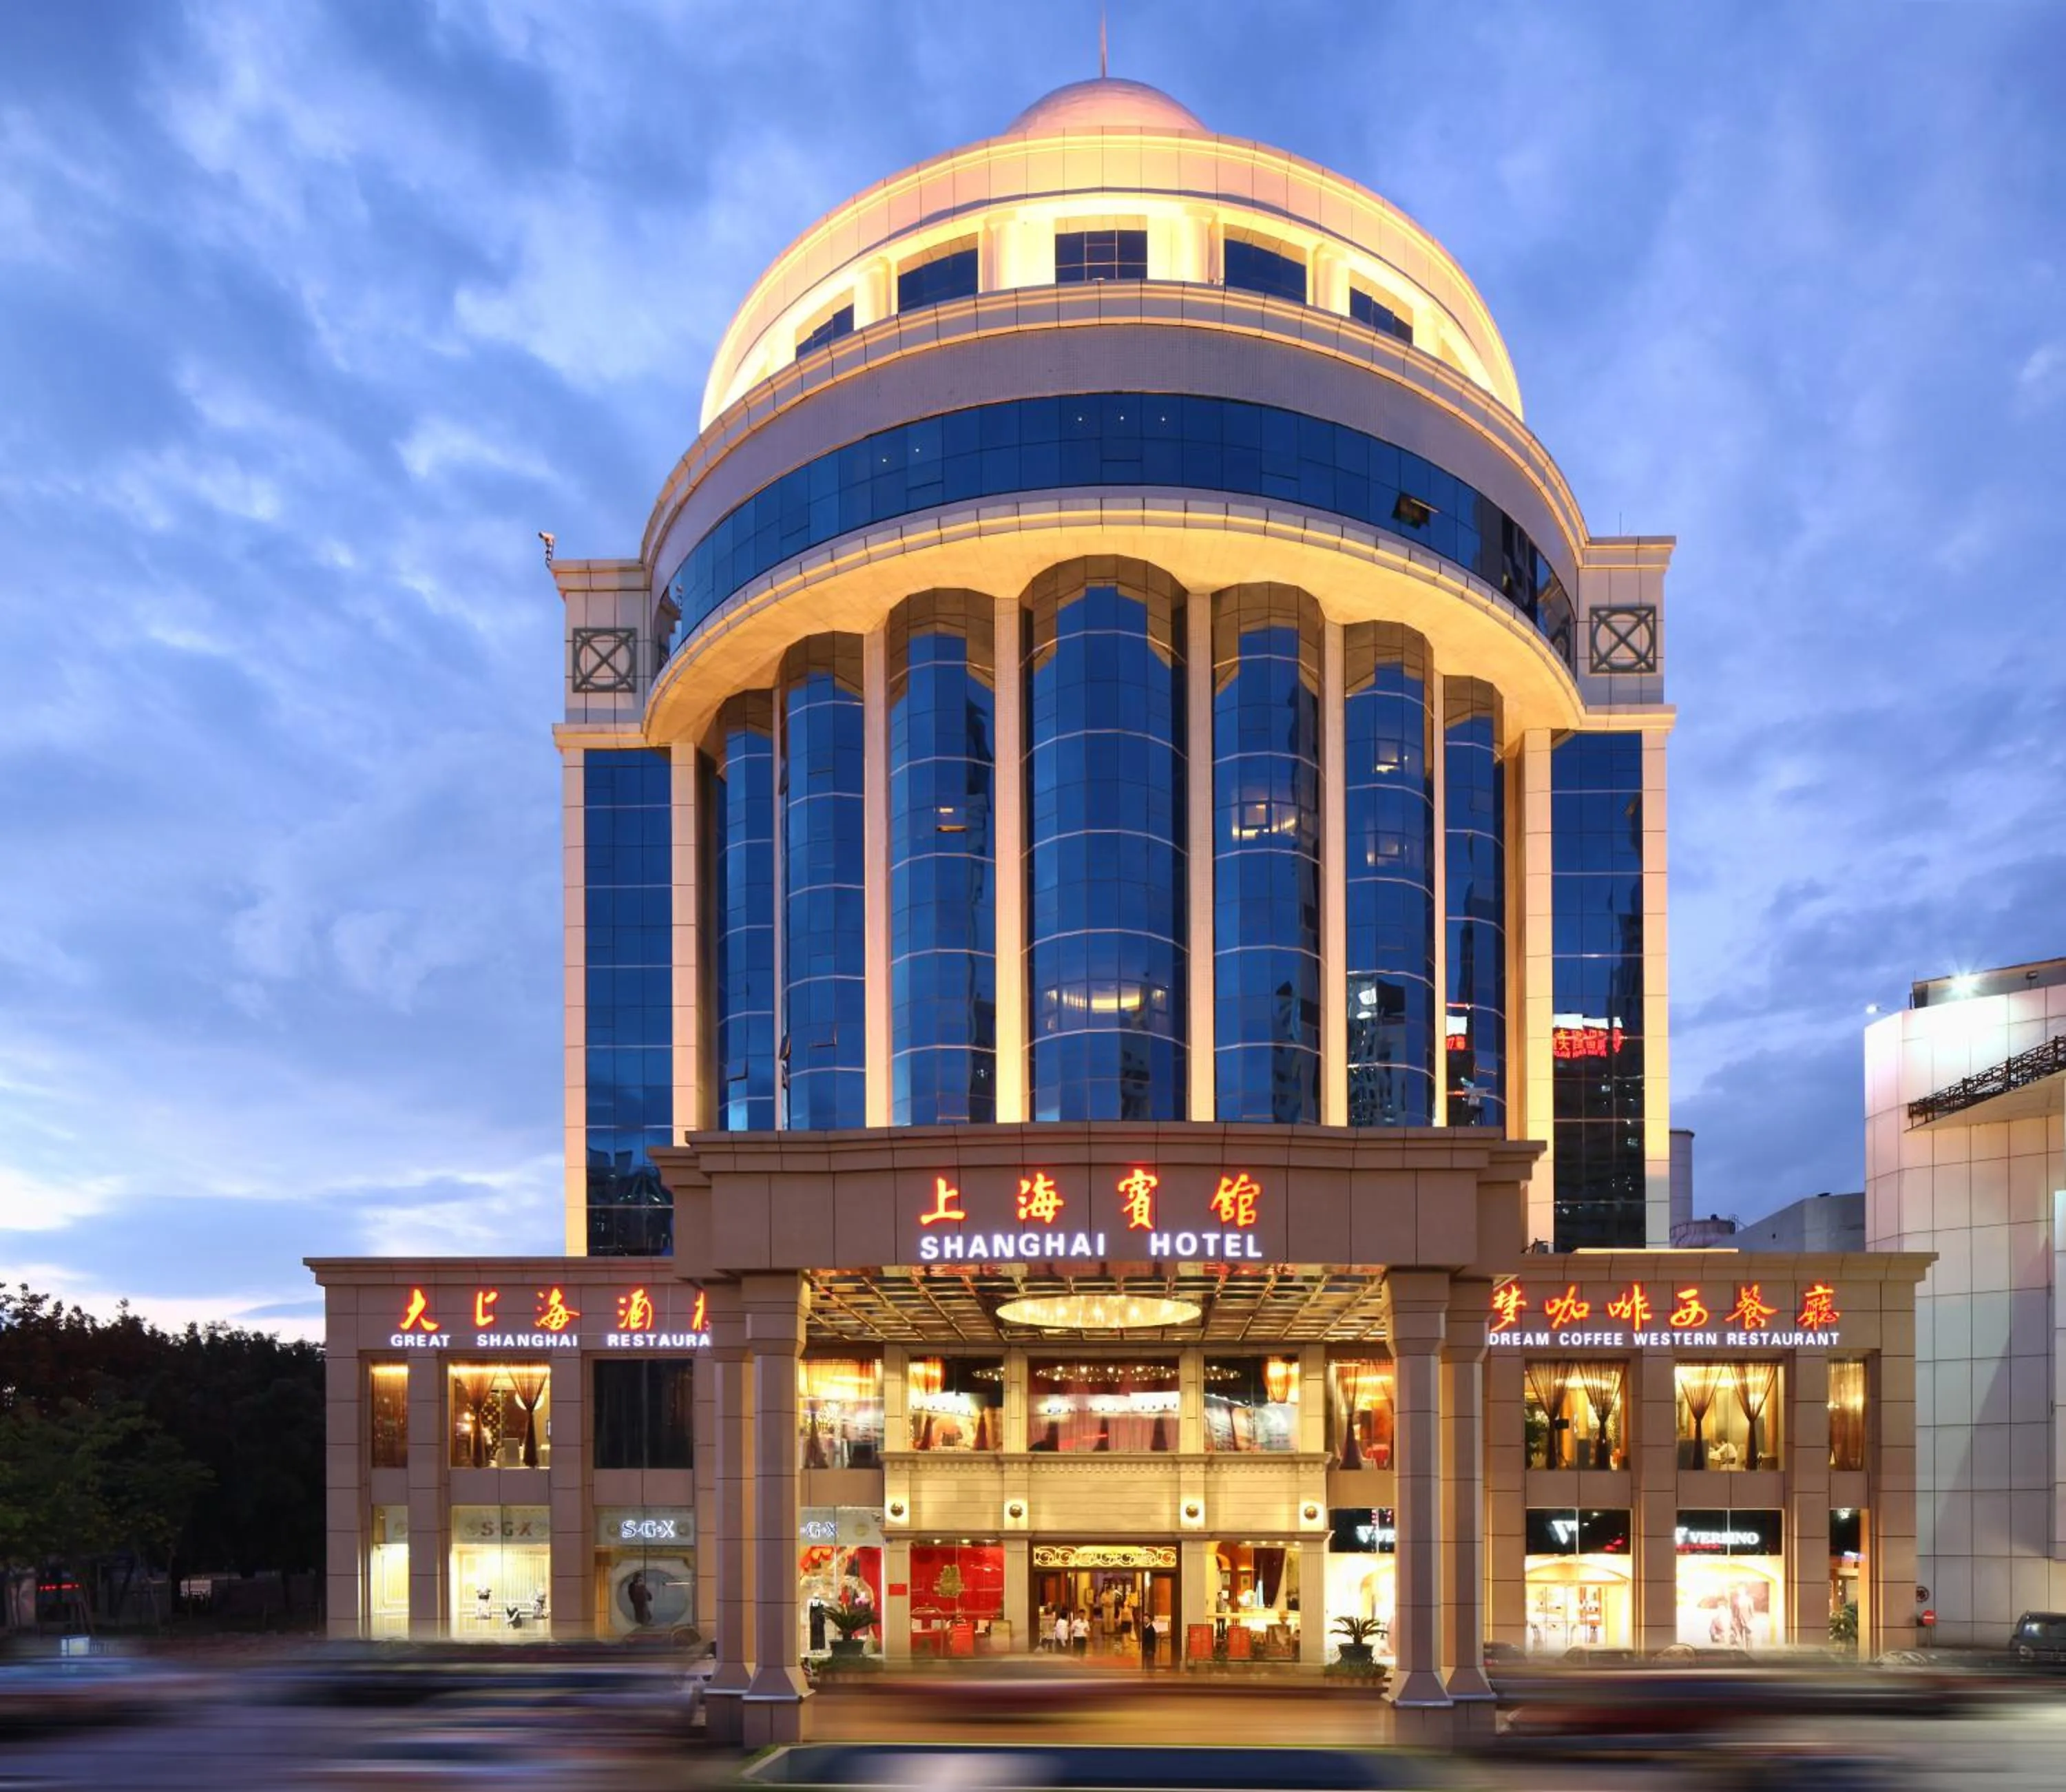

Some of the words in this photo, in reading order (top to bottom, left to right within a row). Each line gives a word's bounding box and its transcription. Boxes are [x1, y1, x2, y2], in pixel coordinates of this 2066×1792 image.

[920, 1233, 1105, 1260] SHANGHAI
[1150, 1232, 1262, 1258] HOTEL
[390, 1334, 450, 1347] GREAT
[477, 1334, 578, 1347] SHANGHAI
[607, 1333, 711, 1347] RESTAURA
[1488, 1331, 1550, 1346] DREAM
[1559, 1332, 1623, 1346] COFFEE
[1634, 1332, 1718, 1346] WESTERN
[1726, 1332, 1840, 1346] RESTAURANT
